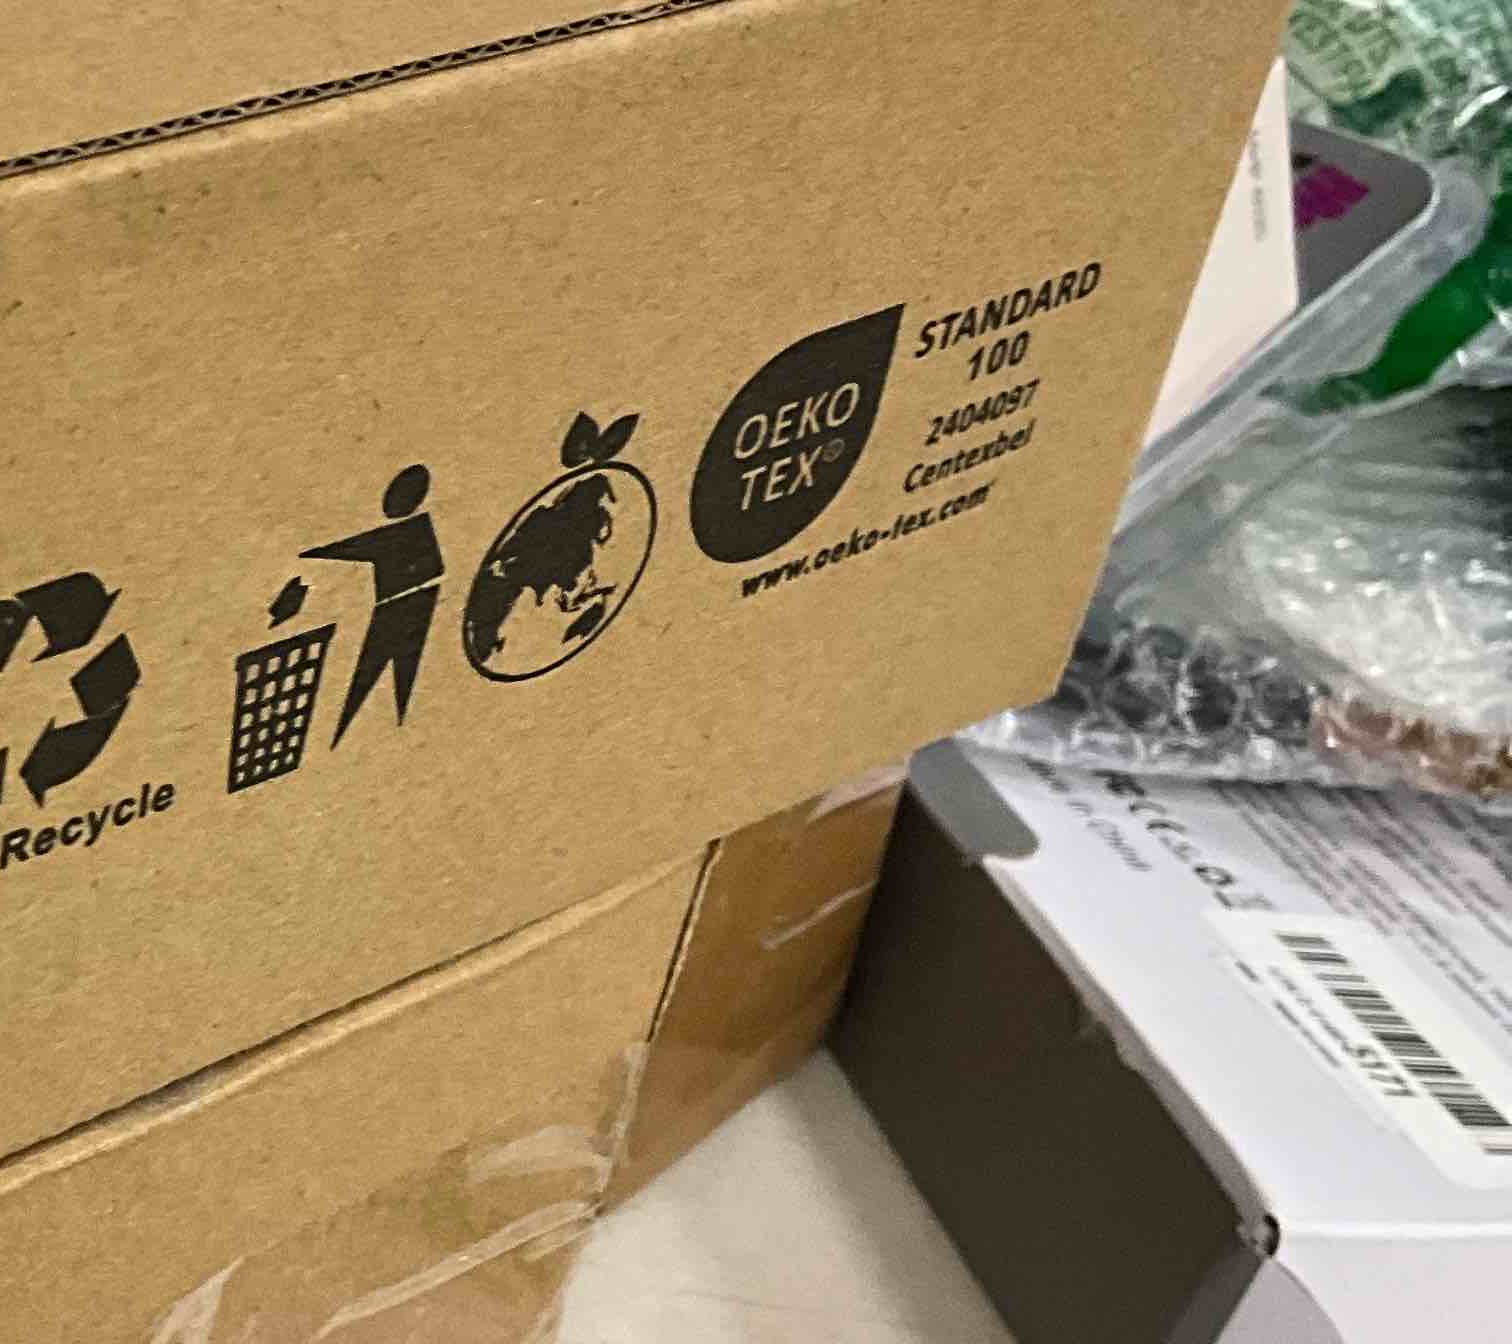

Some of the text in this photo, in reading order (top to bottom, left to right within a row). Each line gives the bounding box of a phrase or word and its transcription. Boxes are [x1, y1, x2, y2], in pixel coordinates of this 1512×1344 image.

[914, 261, 1102, 359] STANDARD
[968, 329, 1032, 381] 100
[733, 382, 860, 460] OEKO
[741, 479, 997, 598] www.oeko-tex.com
